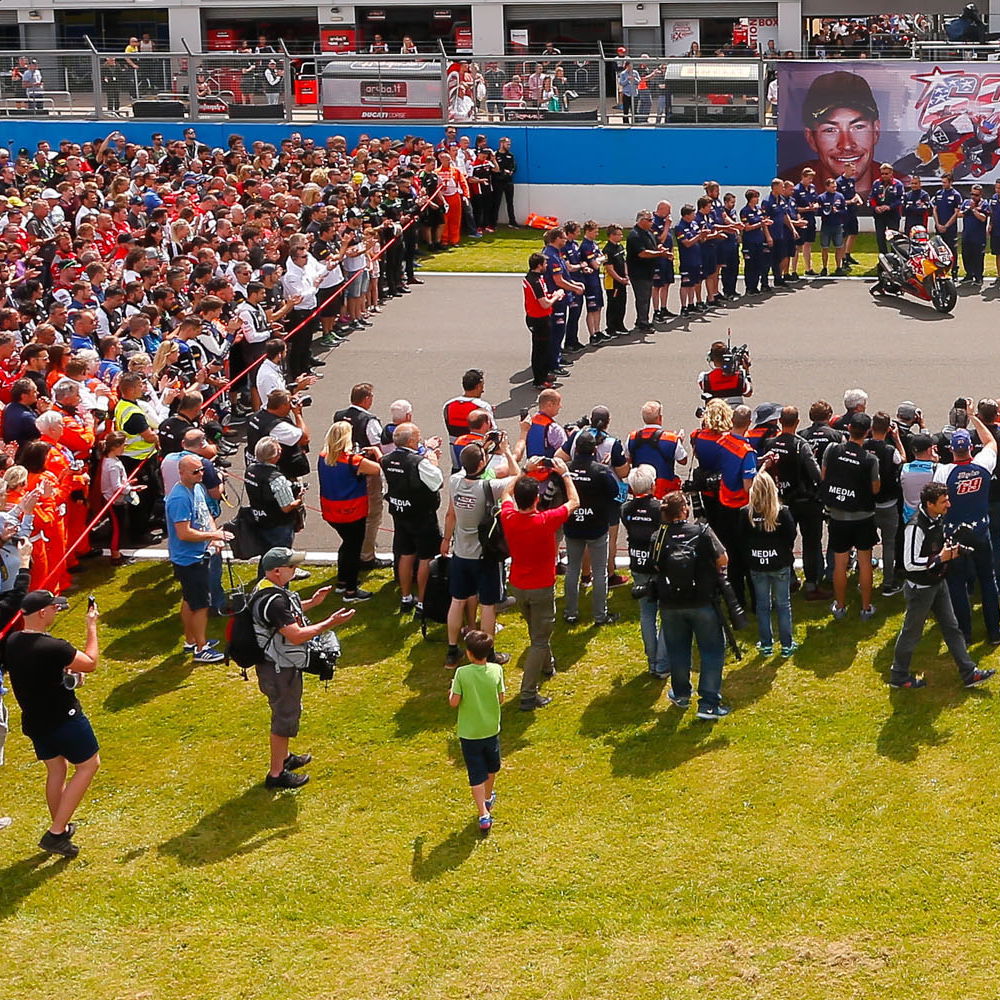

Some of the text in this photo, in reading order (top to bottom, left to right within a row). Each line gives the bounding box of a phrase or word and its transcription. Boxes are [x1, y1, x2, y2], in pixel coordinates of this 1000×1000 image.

[759, 18, 778, 27] BOX
[366, 83, 402, 93] aruba.it
[957, 477, 983, 495] 69
[829, 485, 856, 498] MEDIA
[389, 497, 412, 507] MEDIA
[253, 509, 267, 517] DIA
[629, 548, 650, 558] MEDI
[751, 549, 778, 558] MEDIA
